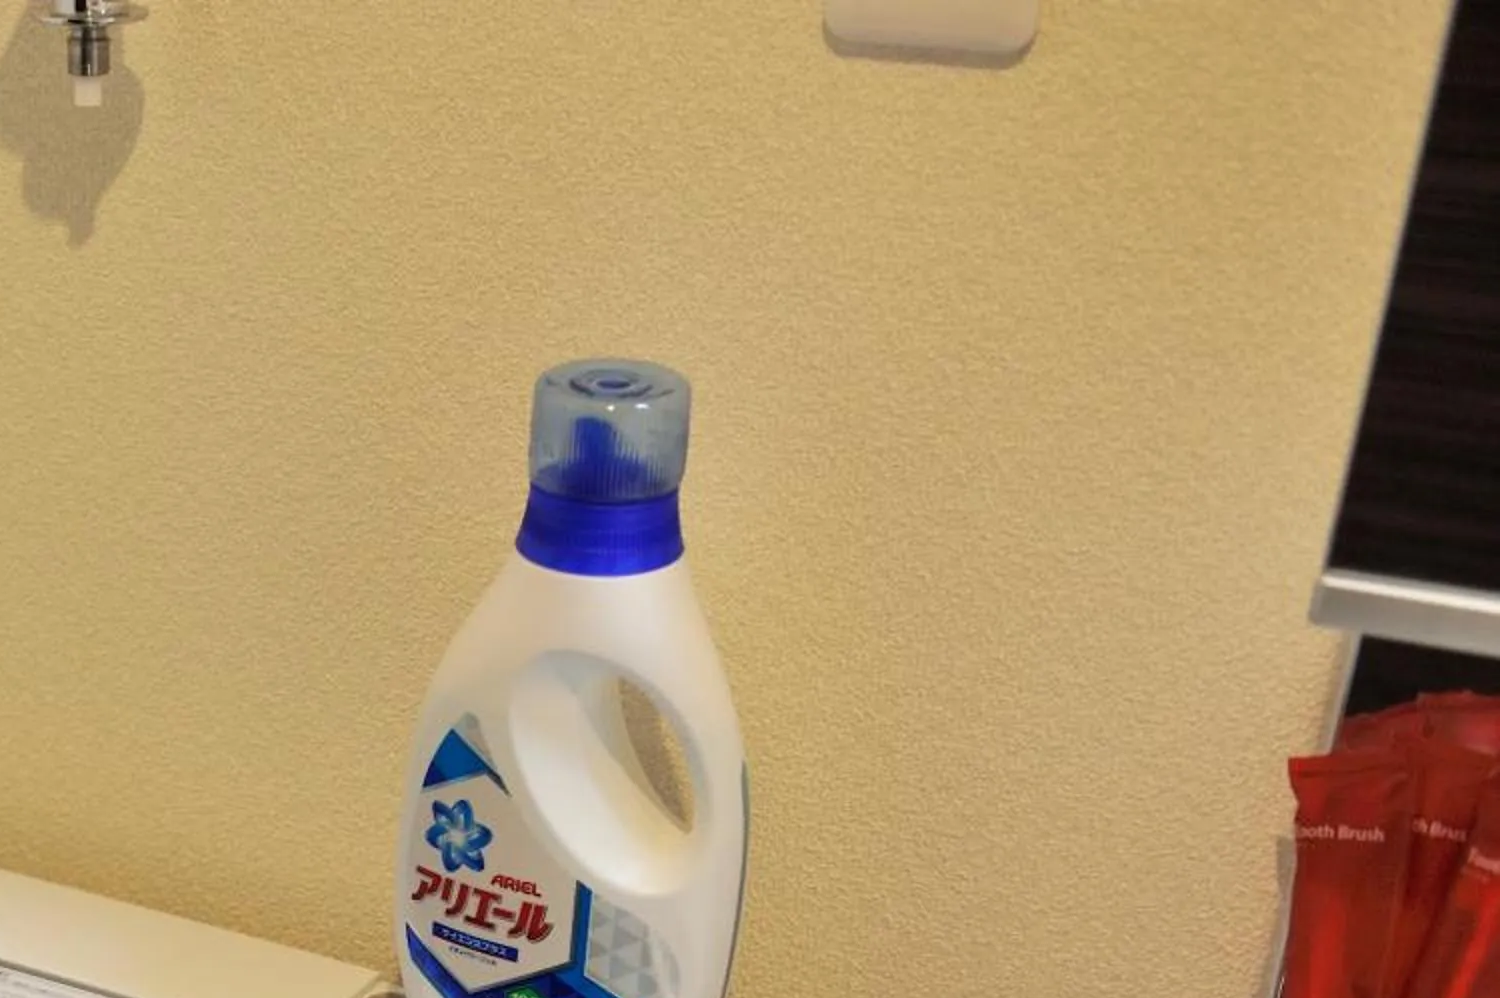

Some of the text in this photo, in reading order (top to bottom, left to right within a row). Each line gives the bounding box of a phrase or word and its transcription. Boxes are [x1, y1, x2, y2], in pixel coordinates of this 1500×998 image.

[1296, 824, 1385, 842] ooth Brush
[490, 873, 542, 897] ARIEL
[411, 864, 553, 943] アリエール
